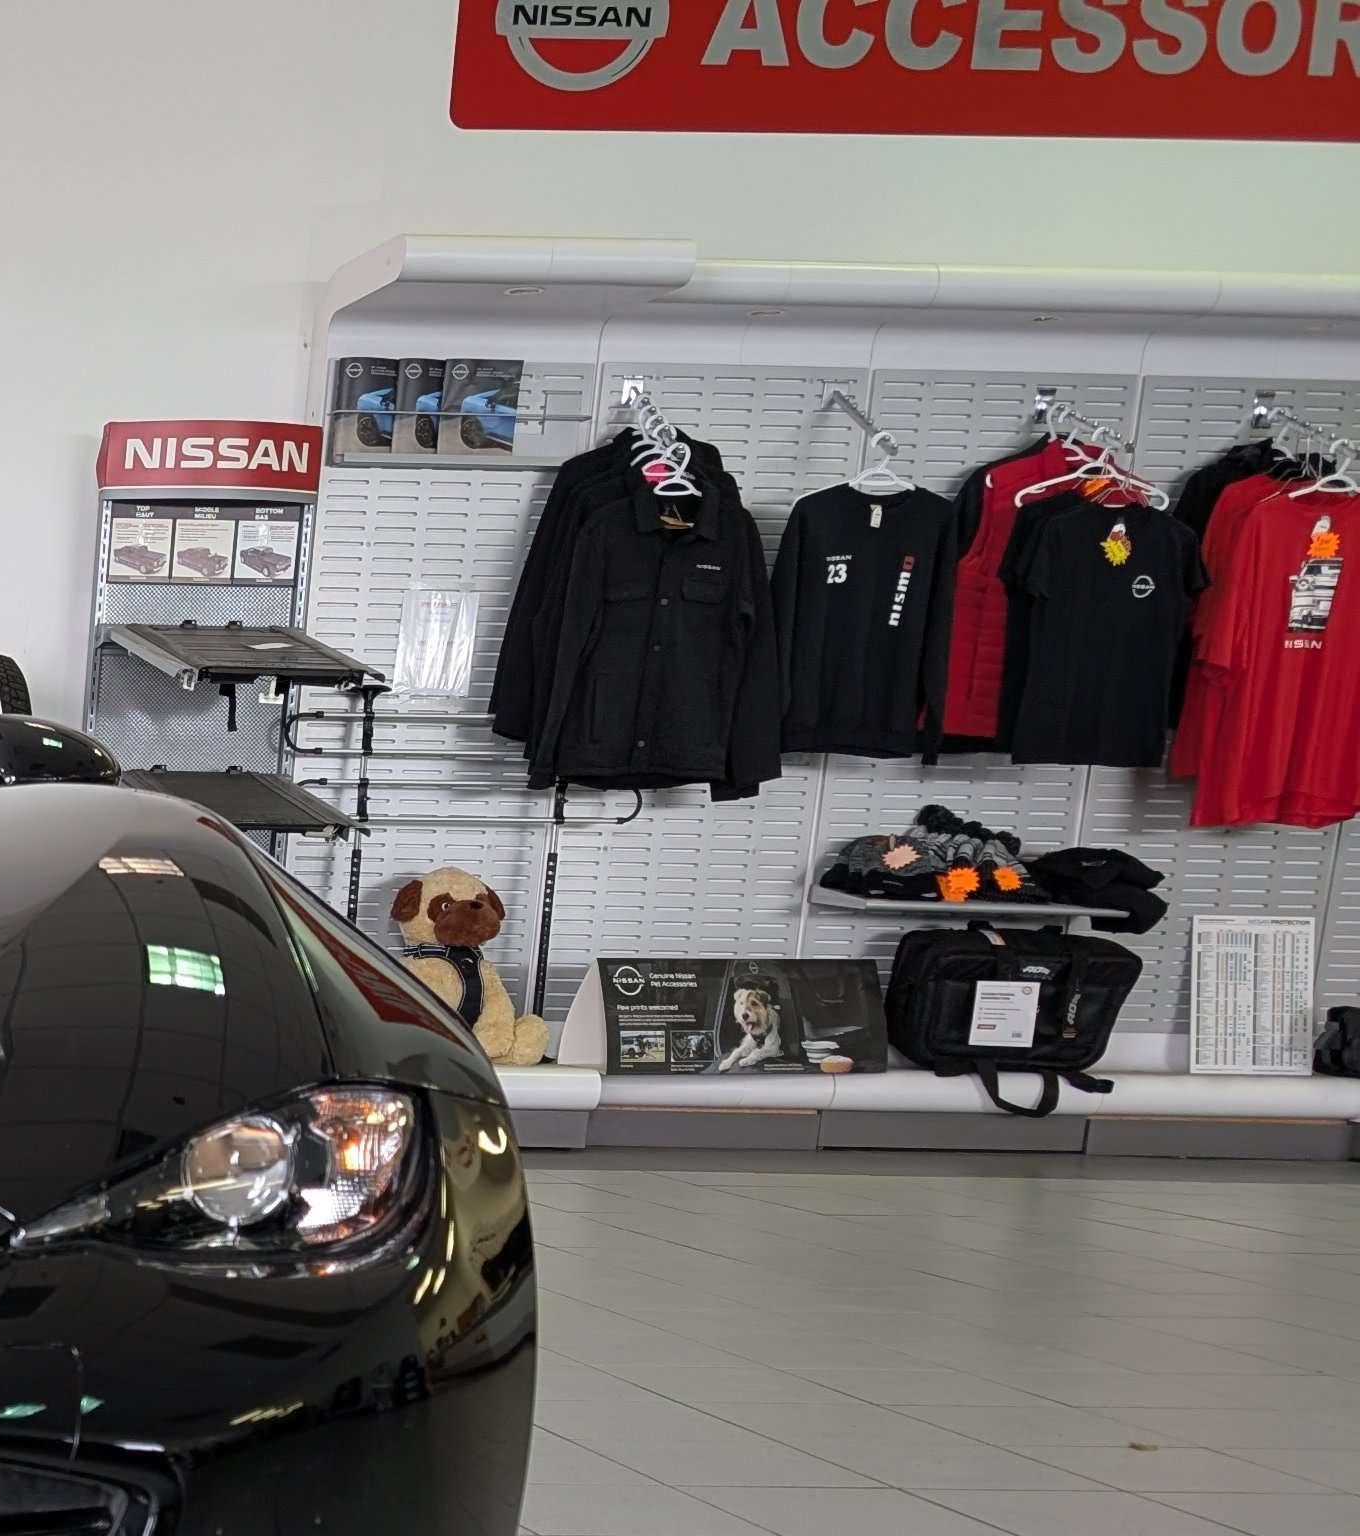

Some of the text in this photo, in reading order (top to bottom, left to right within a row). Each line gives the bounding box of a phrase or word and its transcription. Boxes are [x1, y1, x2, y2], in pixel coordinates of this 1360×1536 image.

[512, 4, 653, 28] NISSAN
[700, 0, 1360, 78] ACCESSOR
[124, 437, 310, 474] NISSAN
[826, 563, 848, 584] 23
[612, 977, 646, 985] NISSAN
